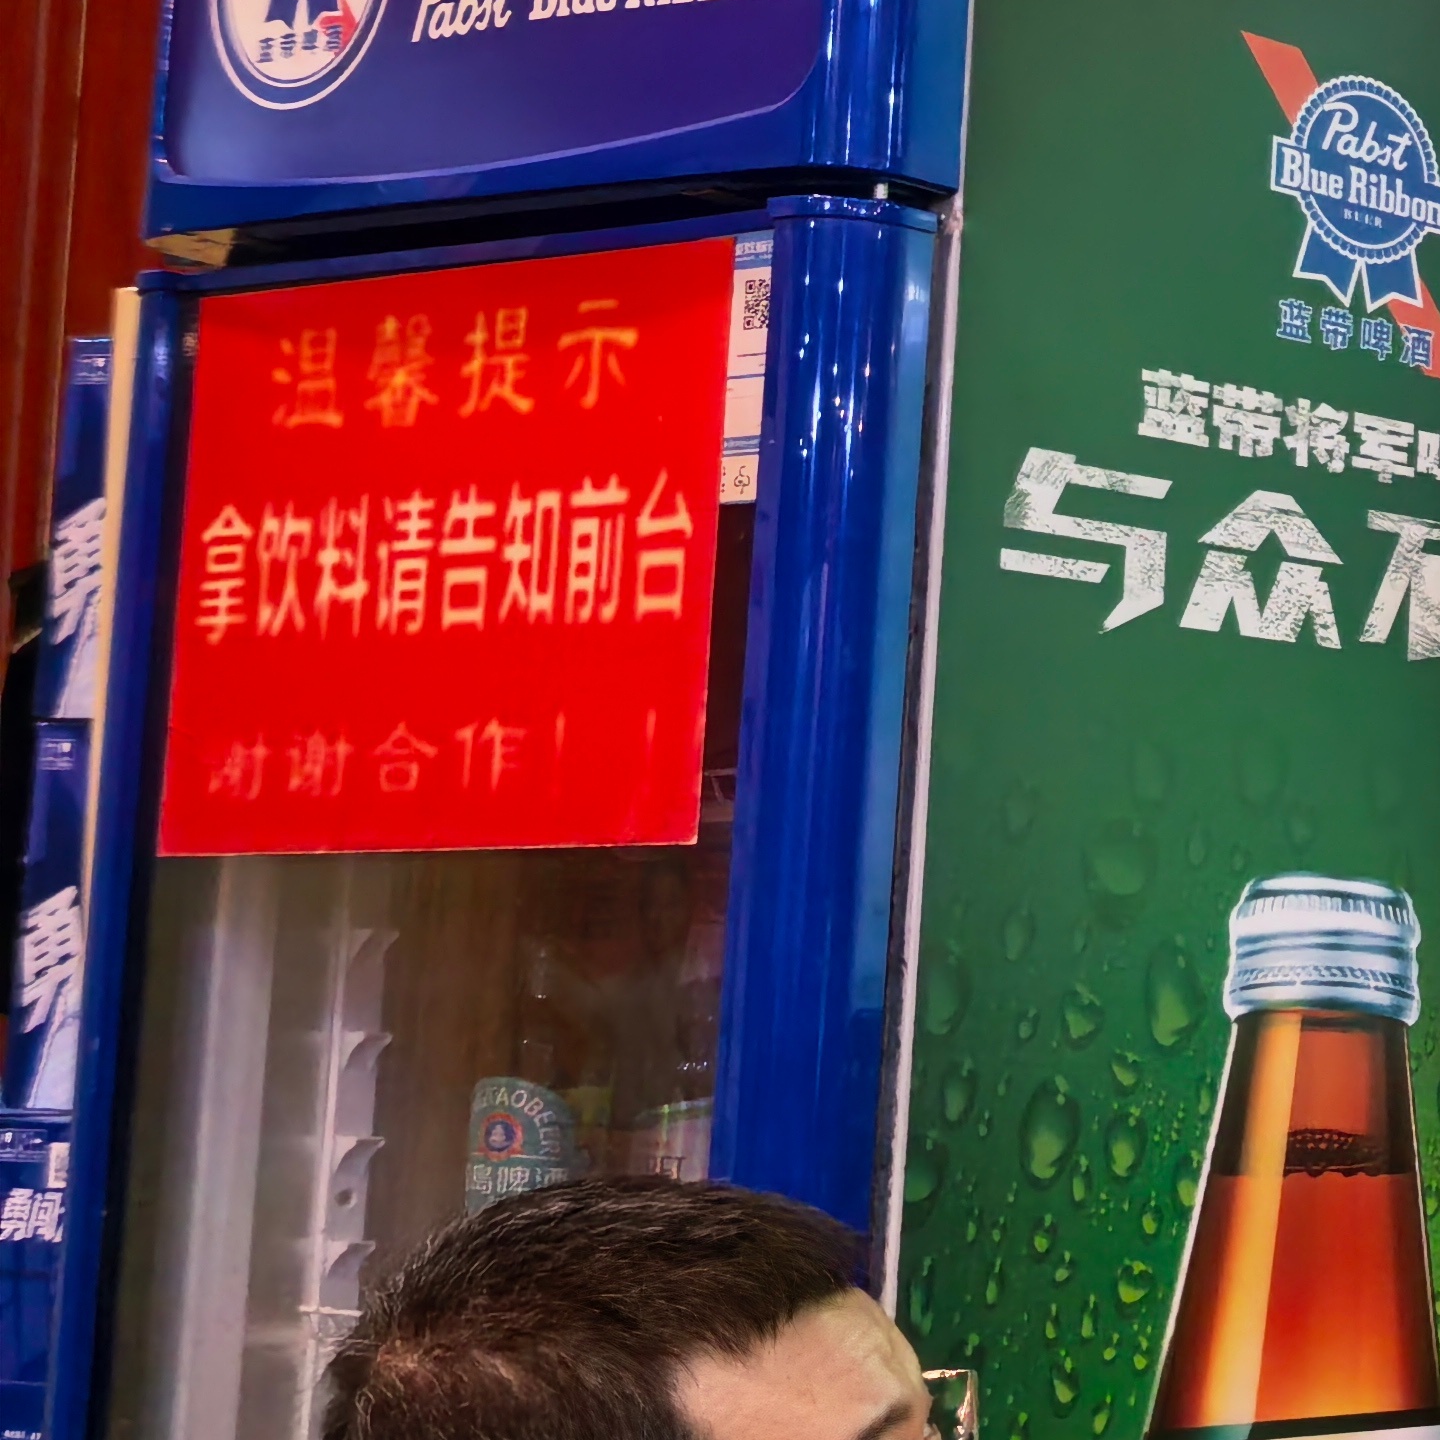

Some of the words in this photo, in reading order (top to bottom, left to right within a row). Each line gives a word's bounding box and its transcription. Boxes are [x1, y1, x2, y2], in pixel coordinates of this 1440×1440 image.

[1279, 146, 1344, 200] Blue
[1321, 101, 1413, 171] Pabst
[271, 299, 638, 430] 温馨提示
[1275, 297, 1435, 371] 蓝带啤酒
[194, 468, 693, 645] 拿饮料请告知前台
